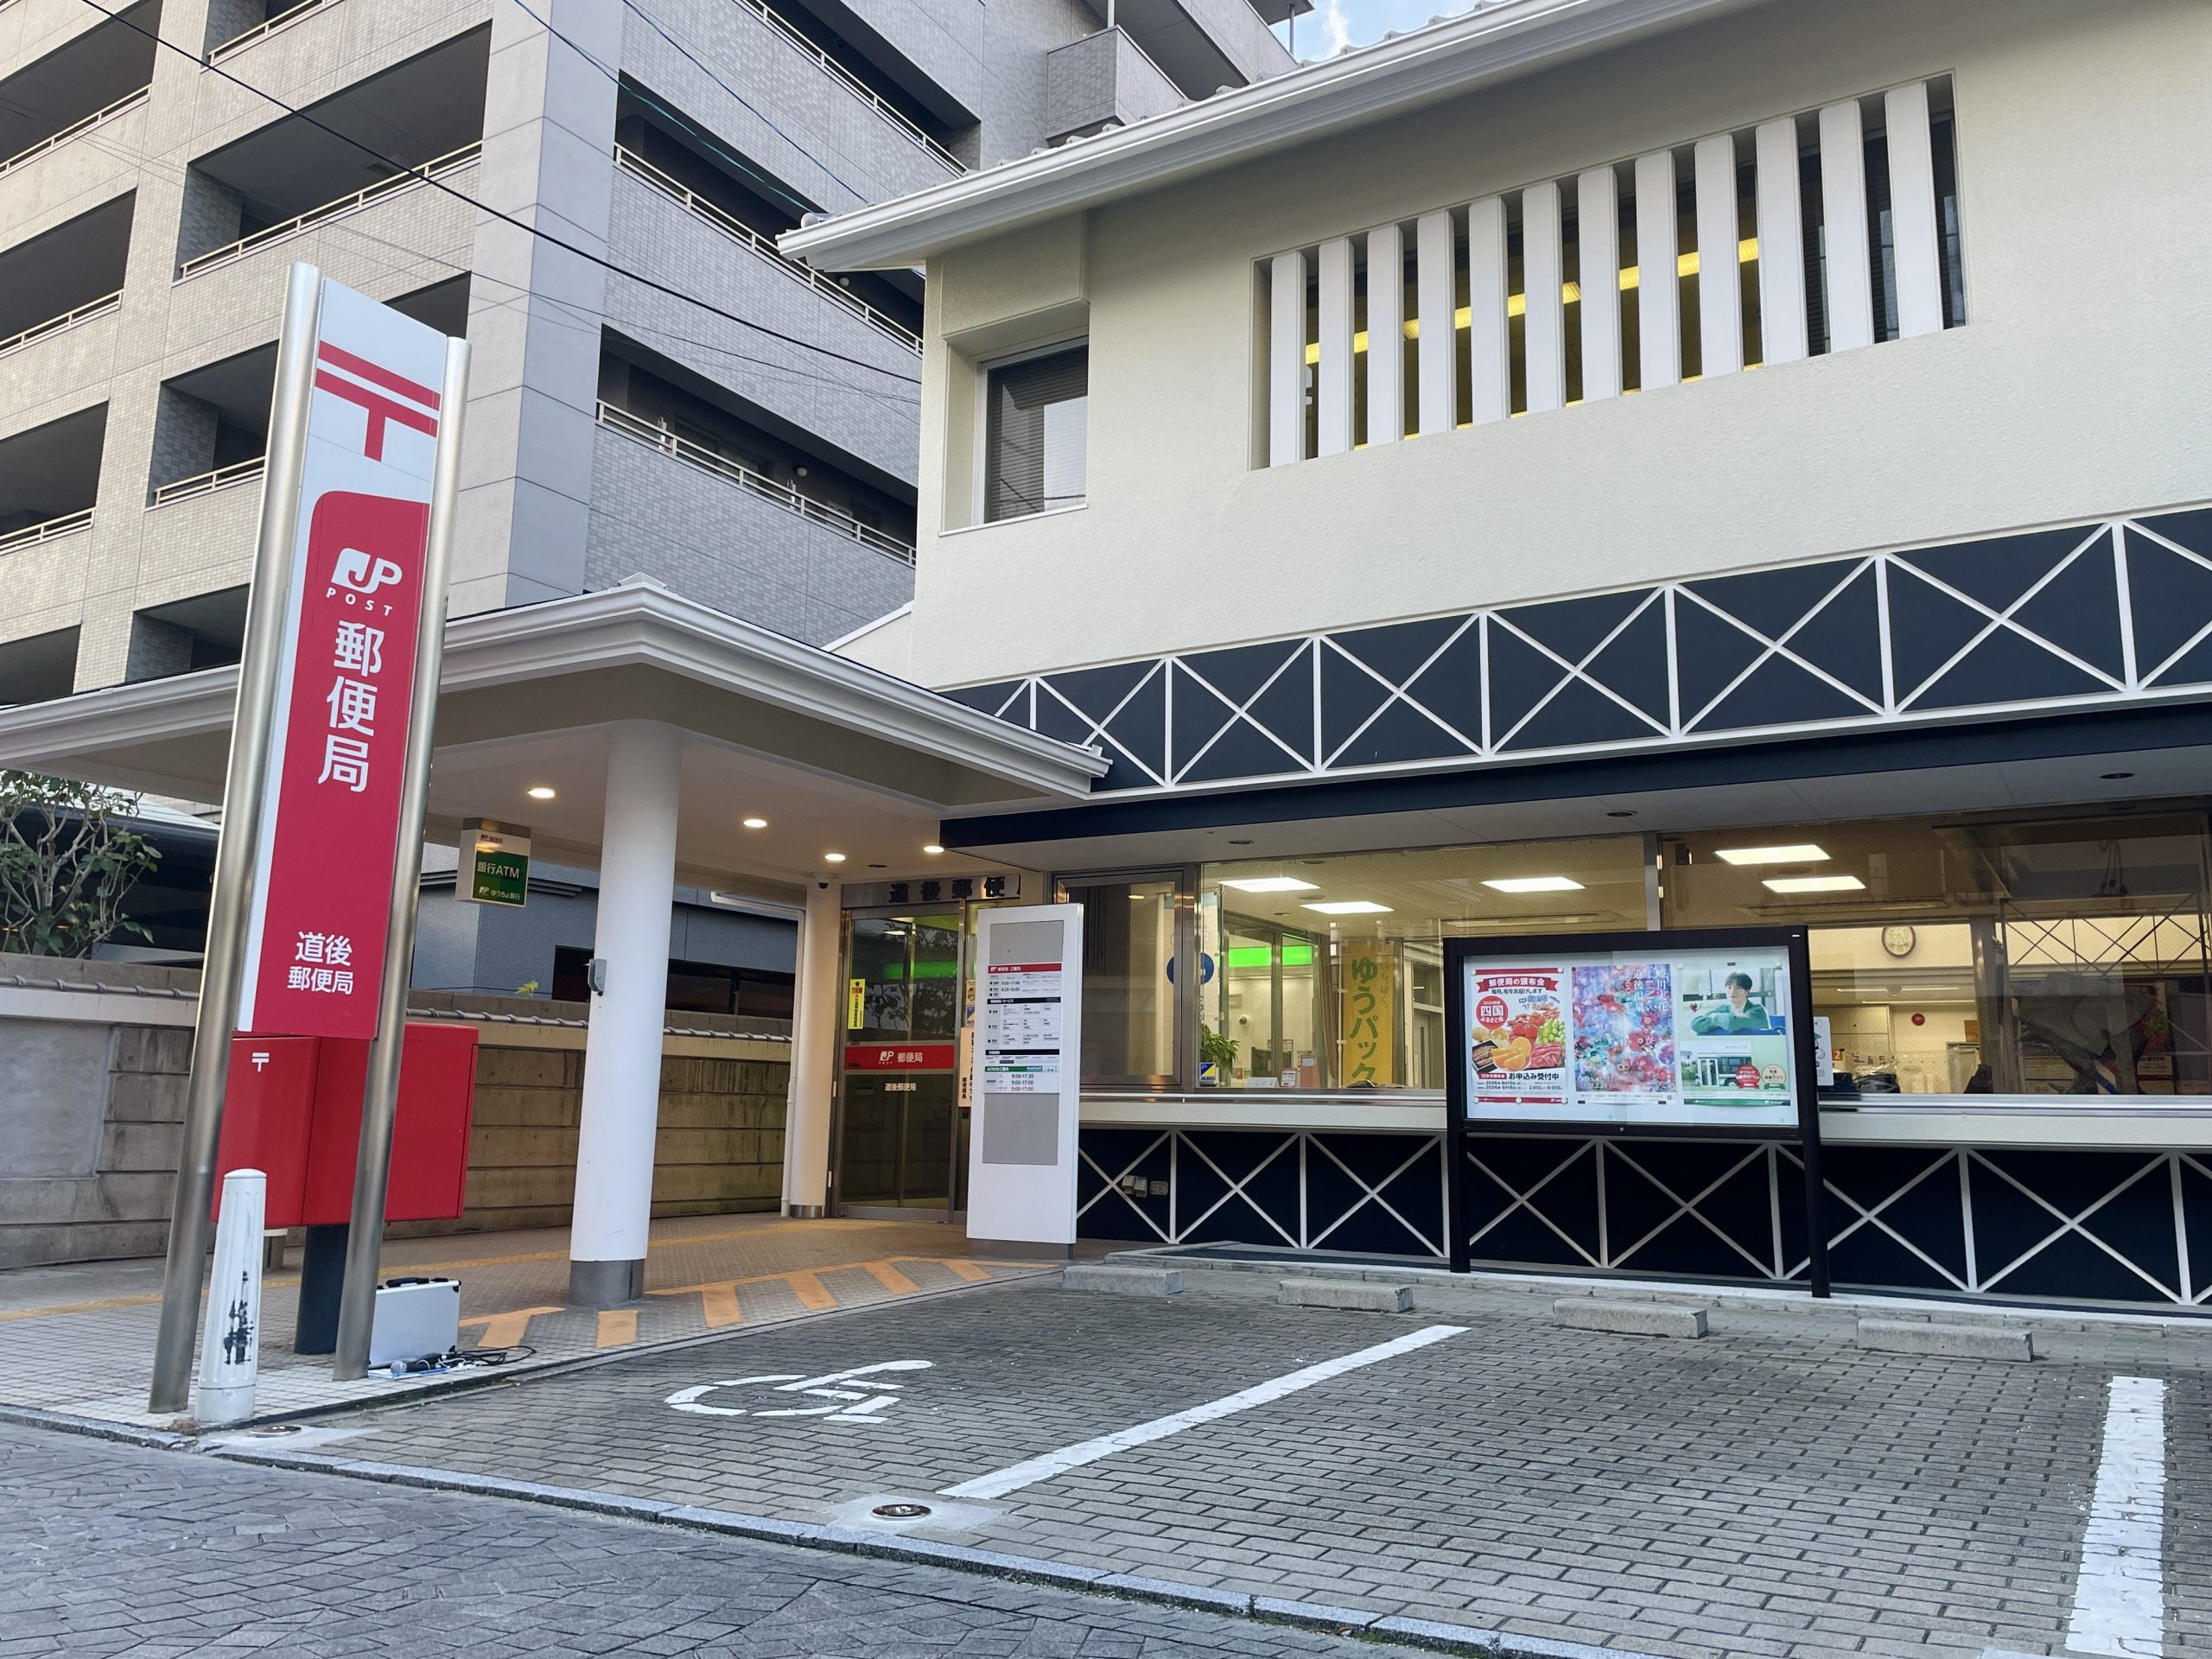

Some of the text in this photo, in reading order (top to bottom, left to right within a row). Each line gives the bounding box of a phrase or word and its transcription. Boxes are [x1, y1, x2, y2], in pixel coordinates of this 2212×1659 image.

[326, 588, 393, 616] POST
[317, 620, 385, 793] 郵便局
[477, 861, 519, 879] 銀行ATM
[888, 874, 1020, 903] 道後郵便
[295, 931, 353, 966] 道後
[287, 966, 353, 995] 郵便局
[1350, 957, 1378, 1080] ゆうパック
[1480, 1005, 1503, 1016] 四国
[898, 1052, 923, 1063] 郵便局
[1834, 1051, 1841, 1059] 2
[885, 1083, 916, 1091] 道後郵便局
